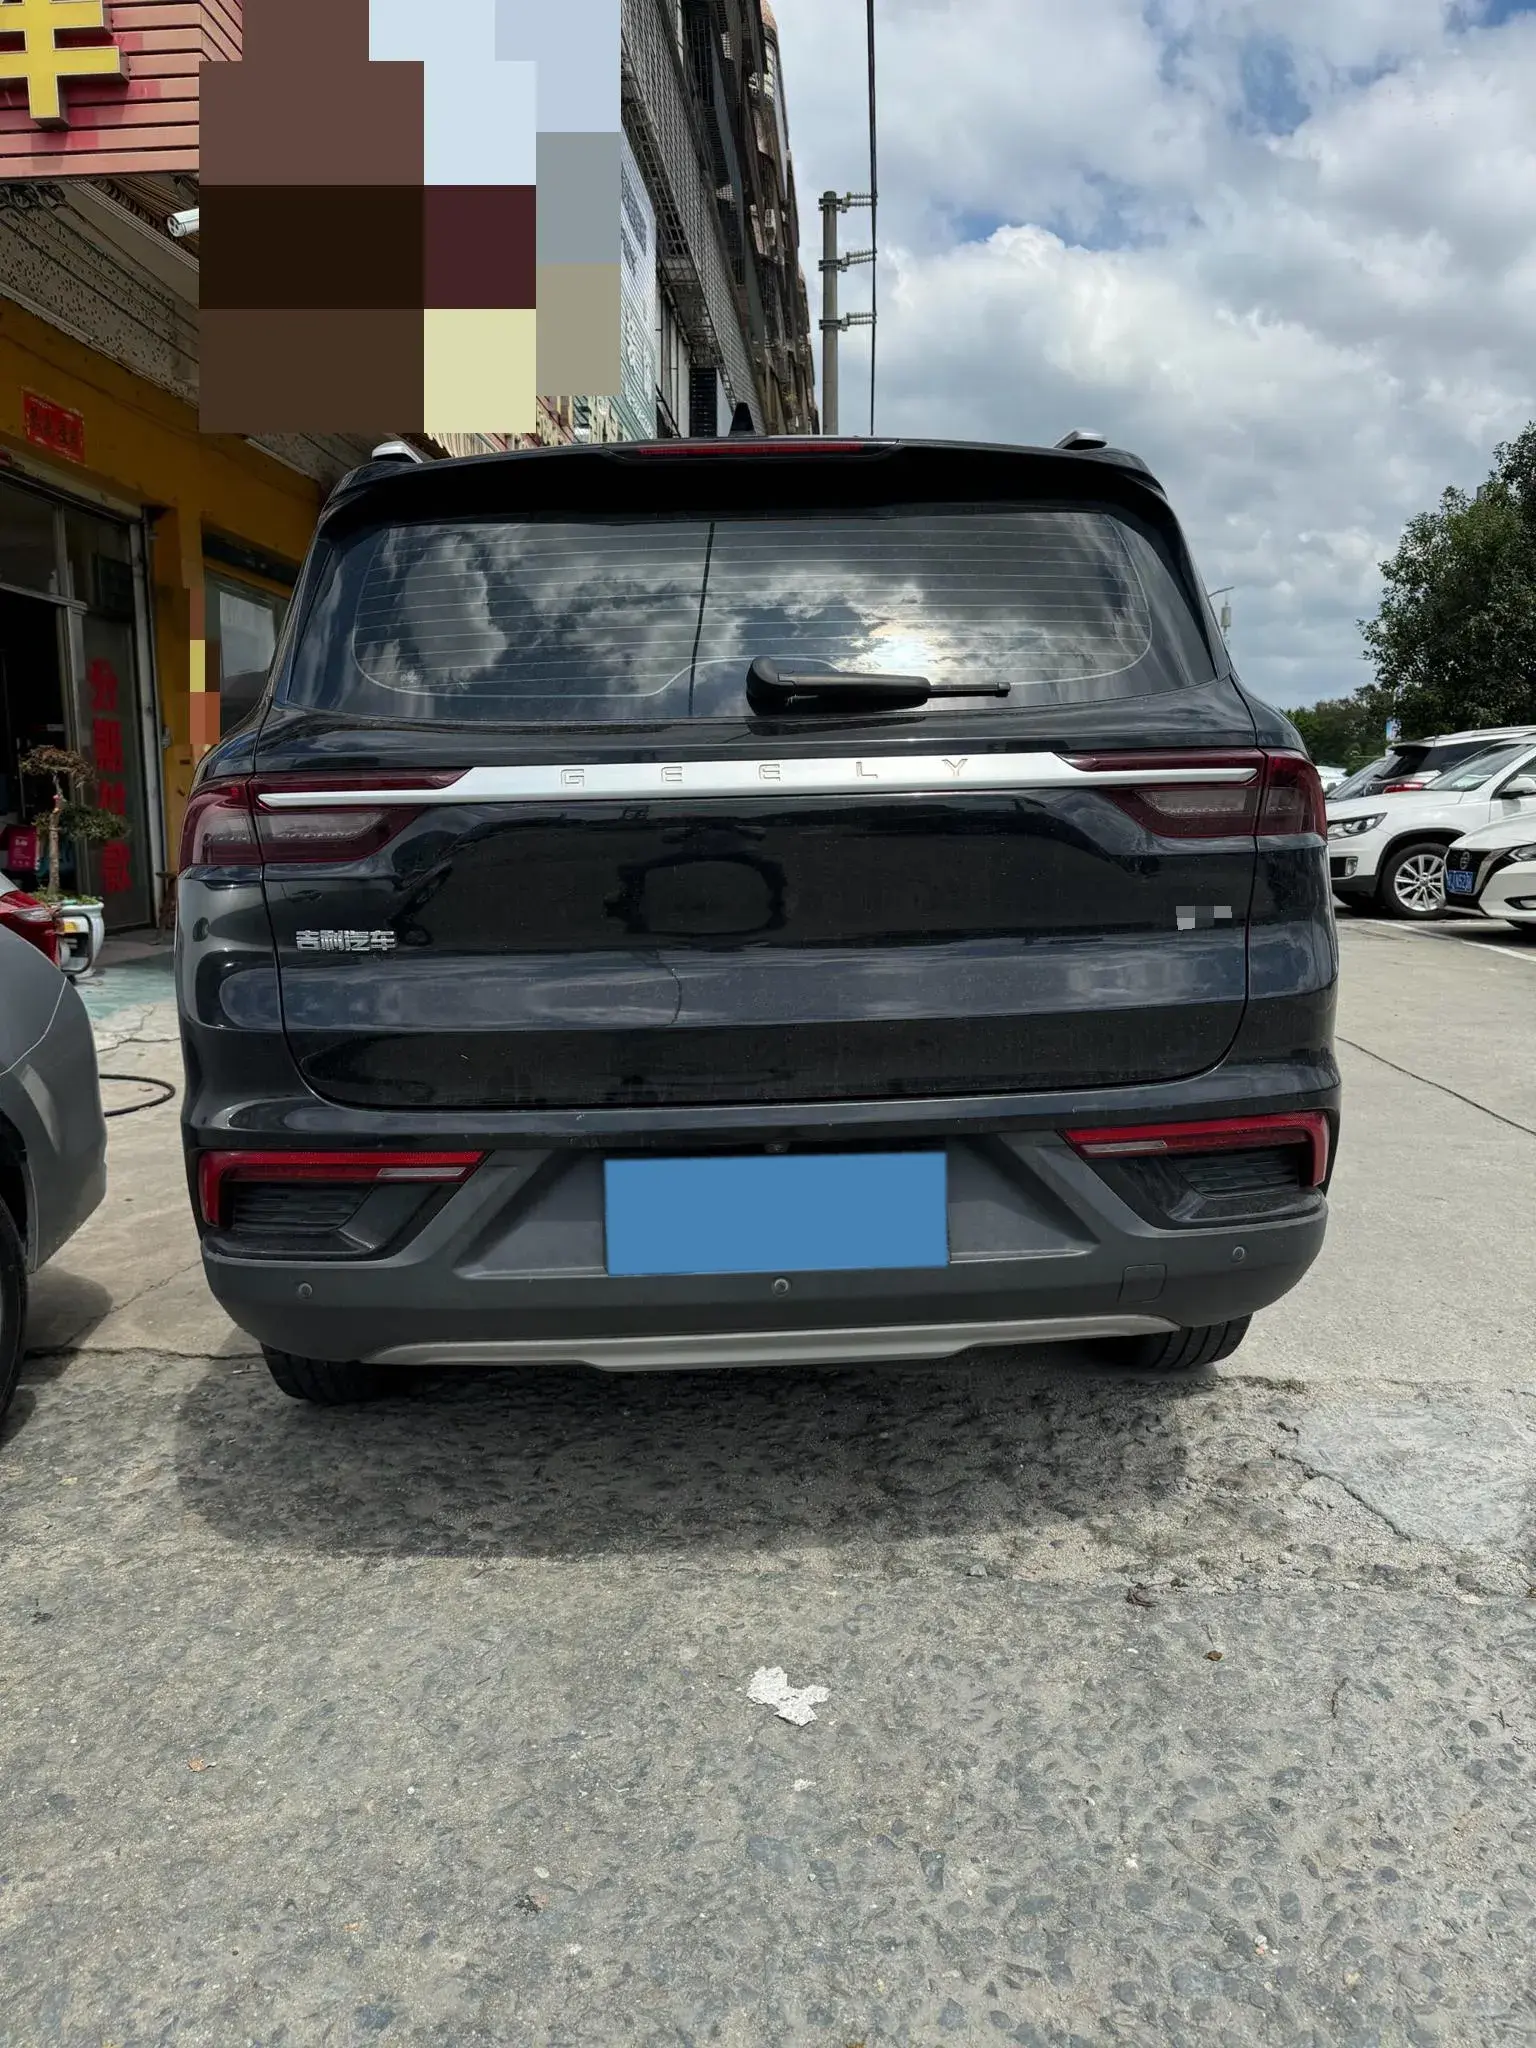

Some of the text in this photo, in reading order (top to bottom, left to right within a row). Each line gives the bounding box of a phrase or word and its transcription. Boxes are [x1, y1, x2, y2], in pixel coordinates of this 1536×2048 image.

[560, 758, 968, 788] GEELY
[295, 929, 396, 951] 吉利汽车
